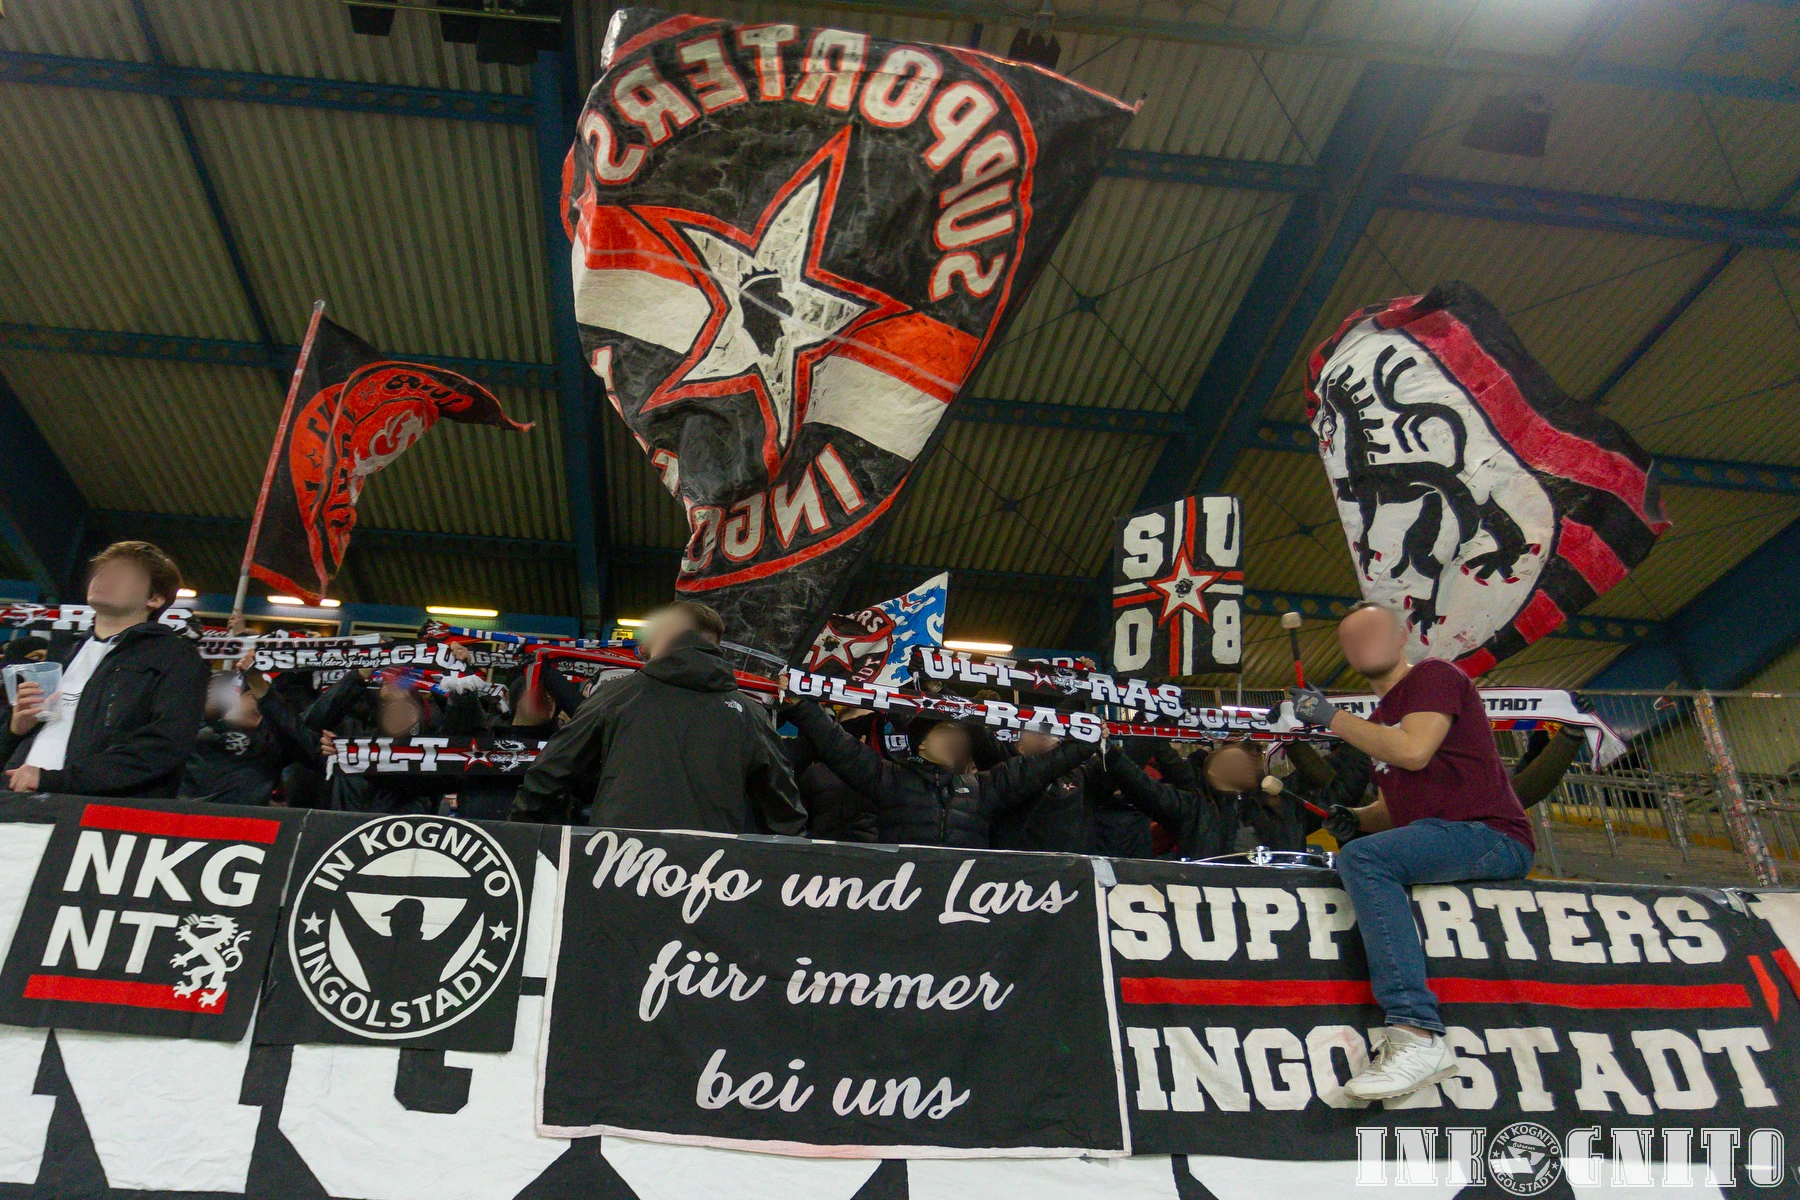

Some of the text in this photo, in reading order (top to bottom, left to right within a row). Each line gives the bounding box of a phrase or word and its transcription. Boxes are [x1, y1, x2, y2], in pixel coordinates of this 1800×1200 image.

[62, 830, 266, 907] NKG
[312, 820, 511, 898] IN KOGNITO
[584, 829, 1078, 924] Mofo und Lars
[41, 905, 180, 974] NT
[1107, 884, 1727, 964] SUPPRTERS
[298, 941, 498, 1028] INGOLSTADT
[638, 940, 1014, 1022] für immer
[696, 1049, 971, 1120] bei uns
